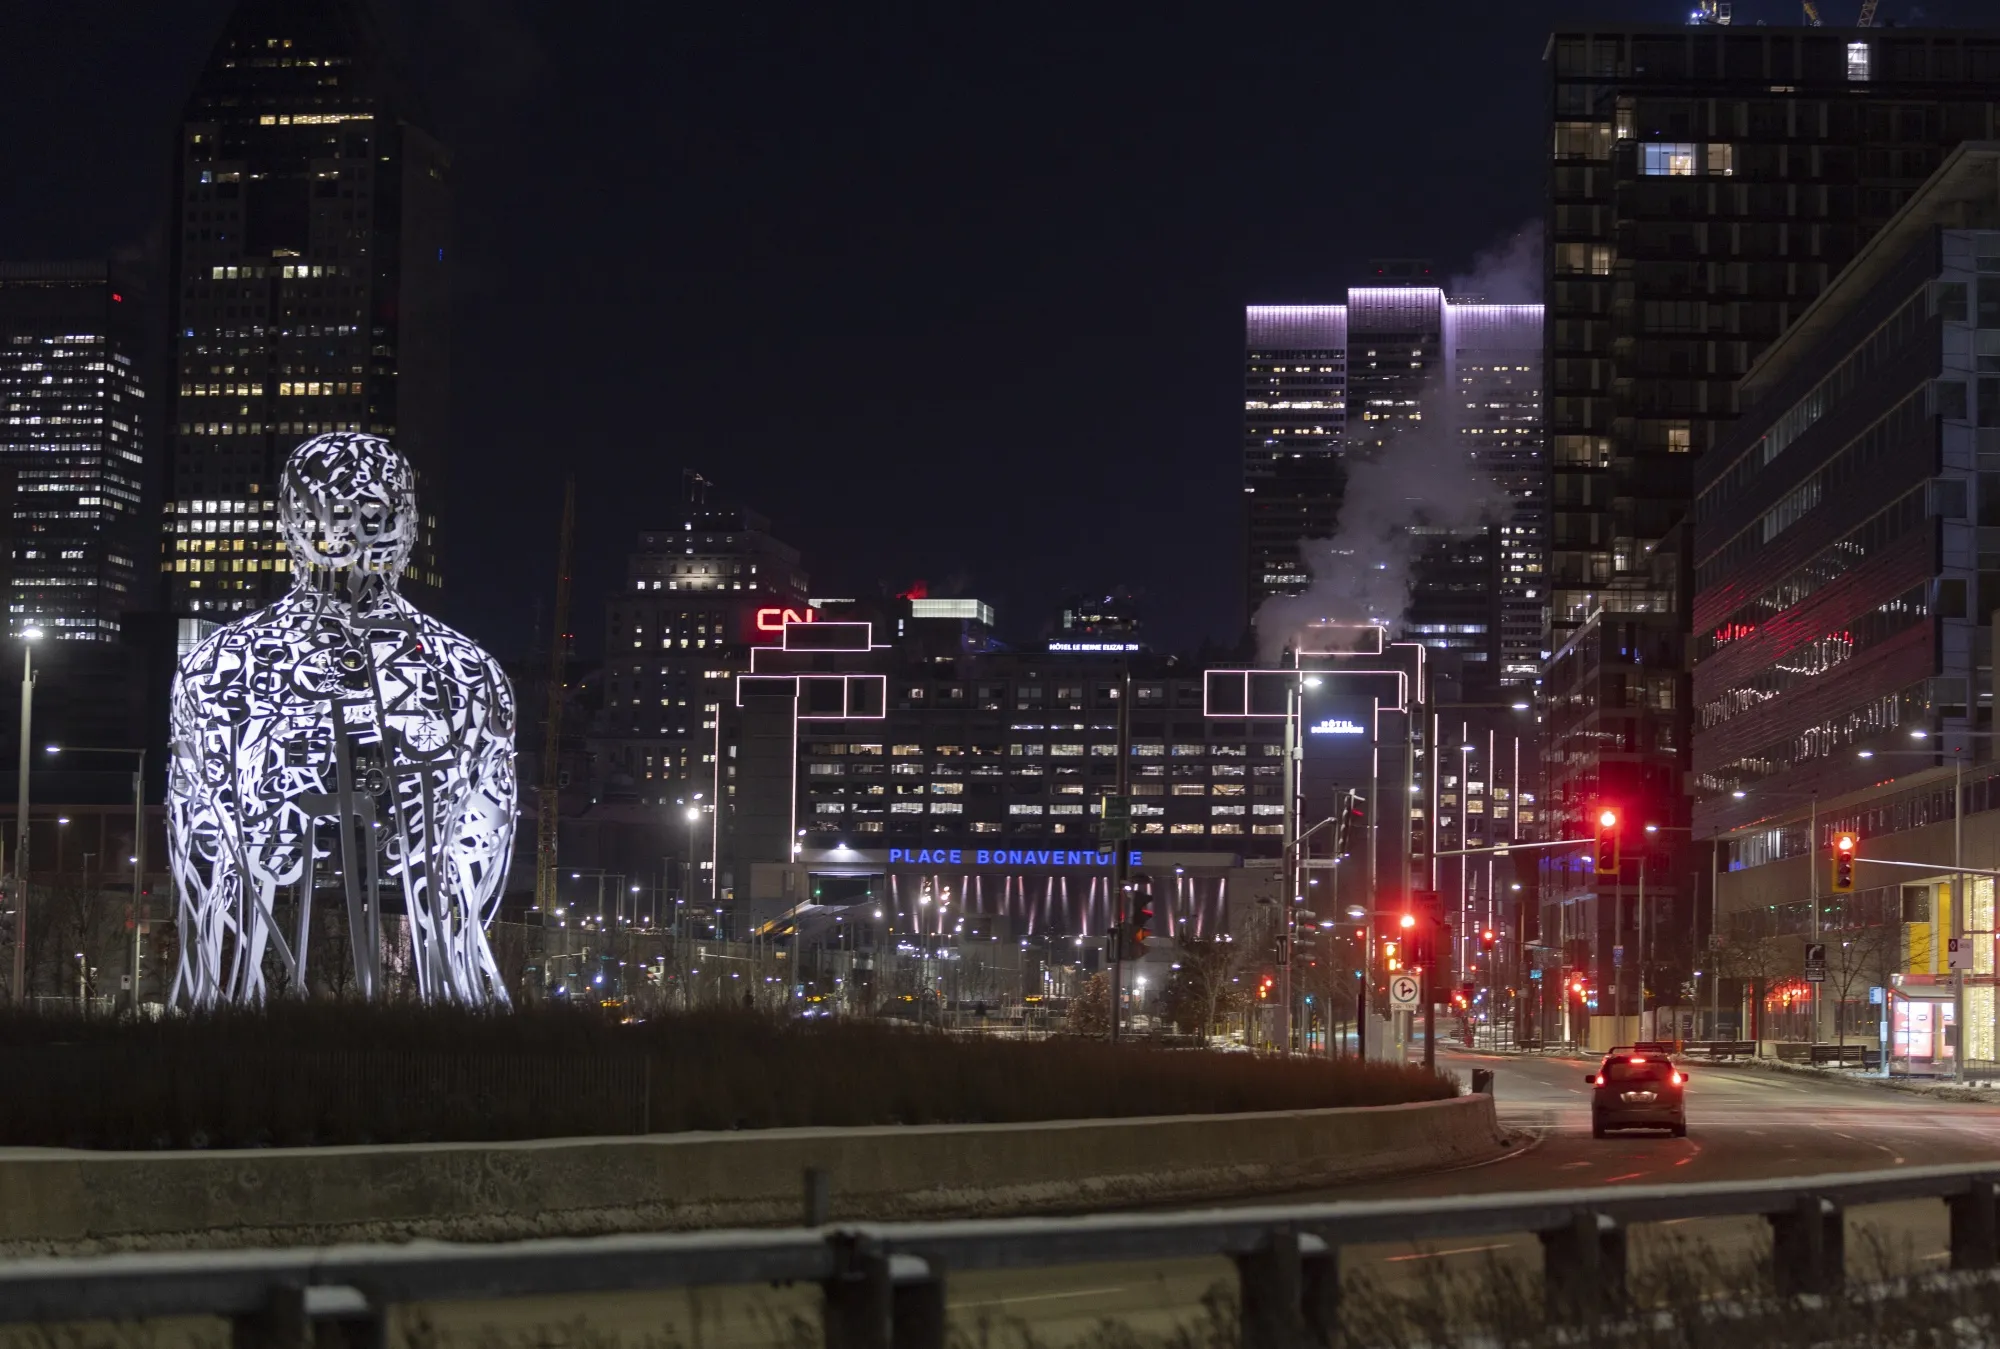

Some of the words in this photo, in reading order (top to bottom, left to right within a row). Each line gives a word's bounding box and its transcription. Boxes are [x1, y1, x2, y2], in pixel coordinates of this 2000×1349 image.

[757, 608, 813, 631] CN
[1049, 643, 1072, 651] HÔTEL
[889, 848, 962, 864] PLACE
[976, 850, 1143, 866] BONAVENTUE
